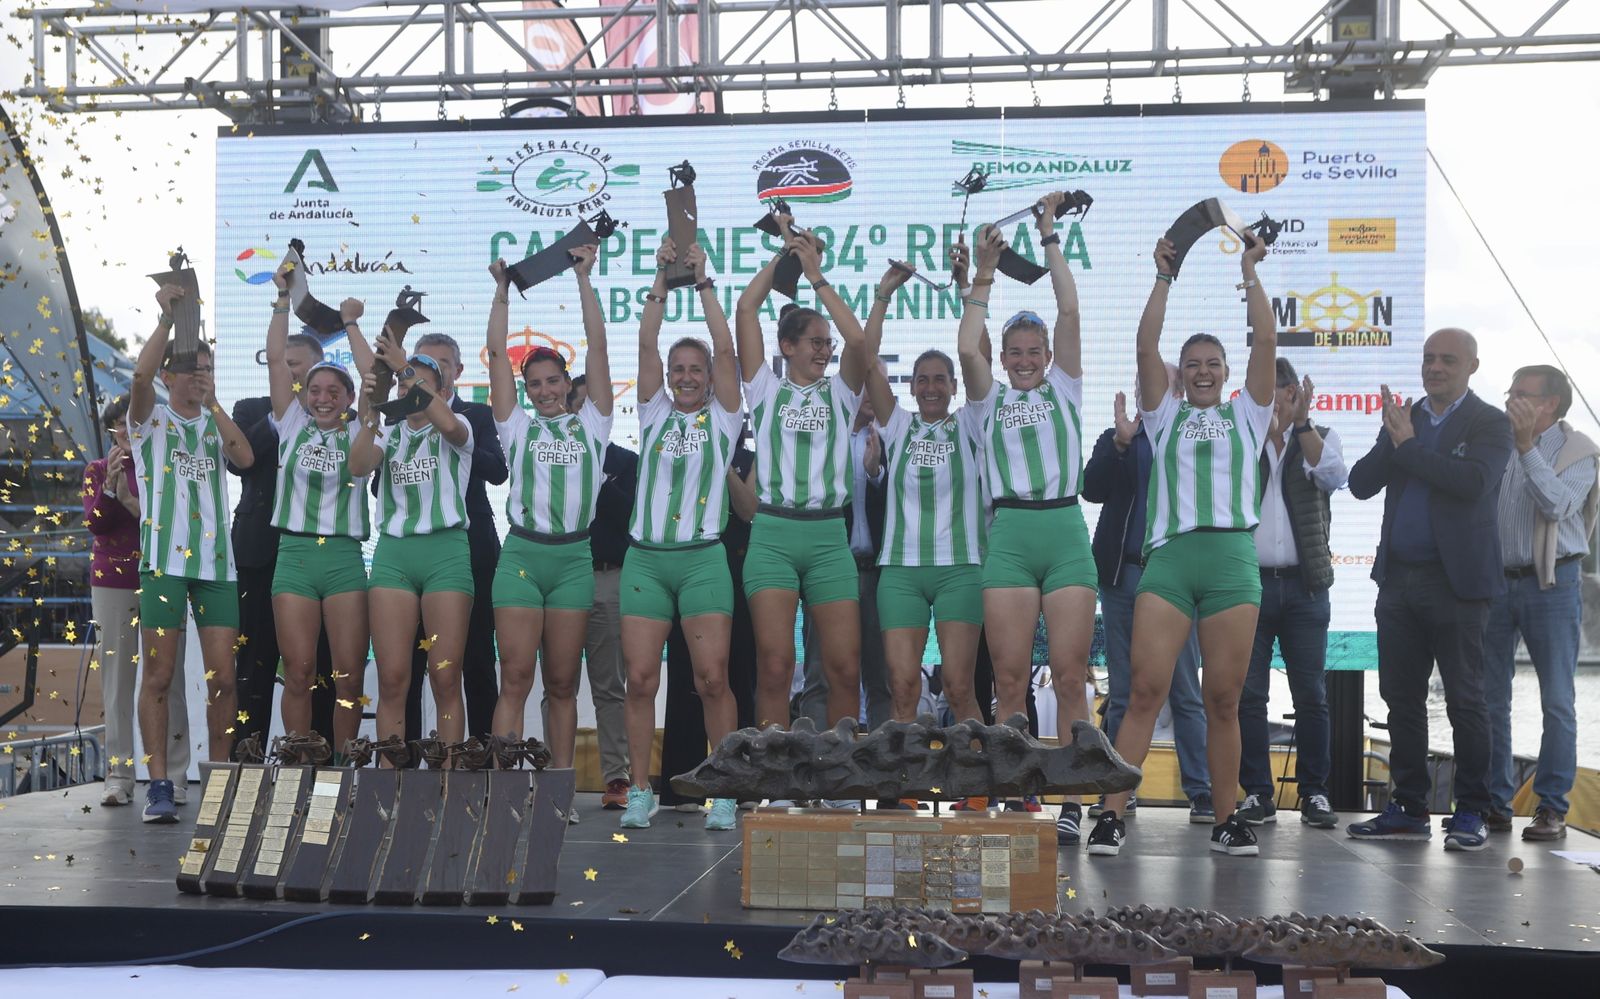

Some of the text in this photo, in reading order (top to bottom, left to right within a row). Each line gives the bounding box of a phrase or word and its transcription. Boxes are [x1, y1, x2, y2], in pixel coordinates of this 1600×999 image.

[506, 140, 612, 165] FEDERACION
[1302, 151, 1376, 164] Puerto
[972, 160, 1133, 175] REMOANDALUZ
[1302, 164, 1397, 180] de Sevilla
[293, 198, 330, 209] Junta
[506, 194, 573, 217] ANDALUZA
[269, 207, 354, 220] de Andalucía
[1314, 331, 1390, 347] DE TRIANA
[785, 418, 825, 431] GREEN
[1004, 413, 1047, 429] GREEN
[538, 451, 578, 464] GREEN
[393, 471, 431, 485] GREEN
